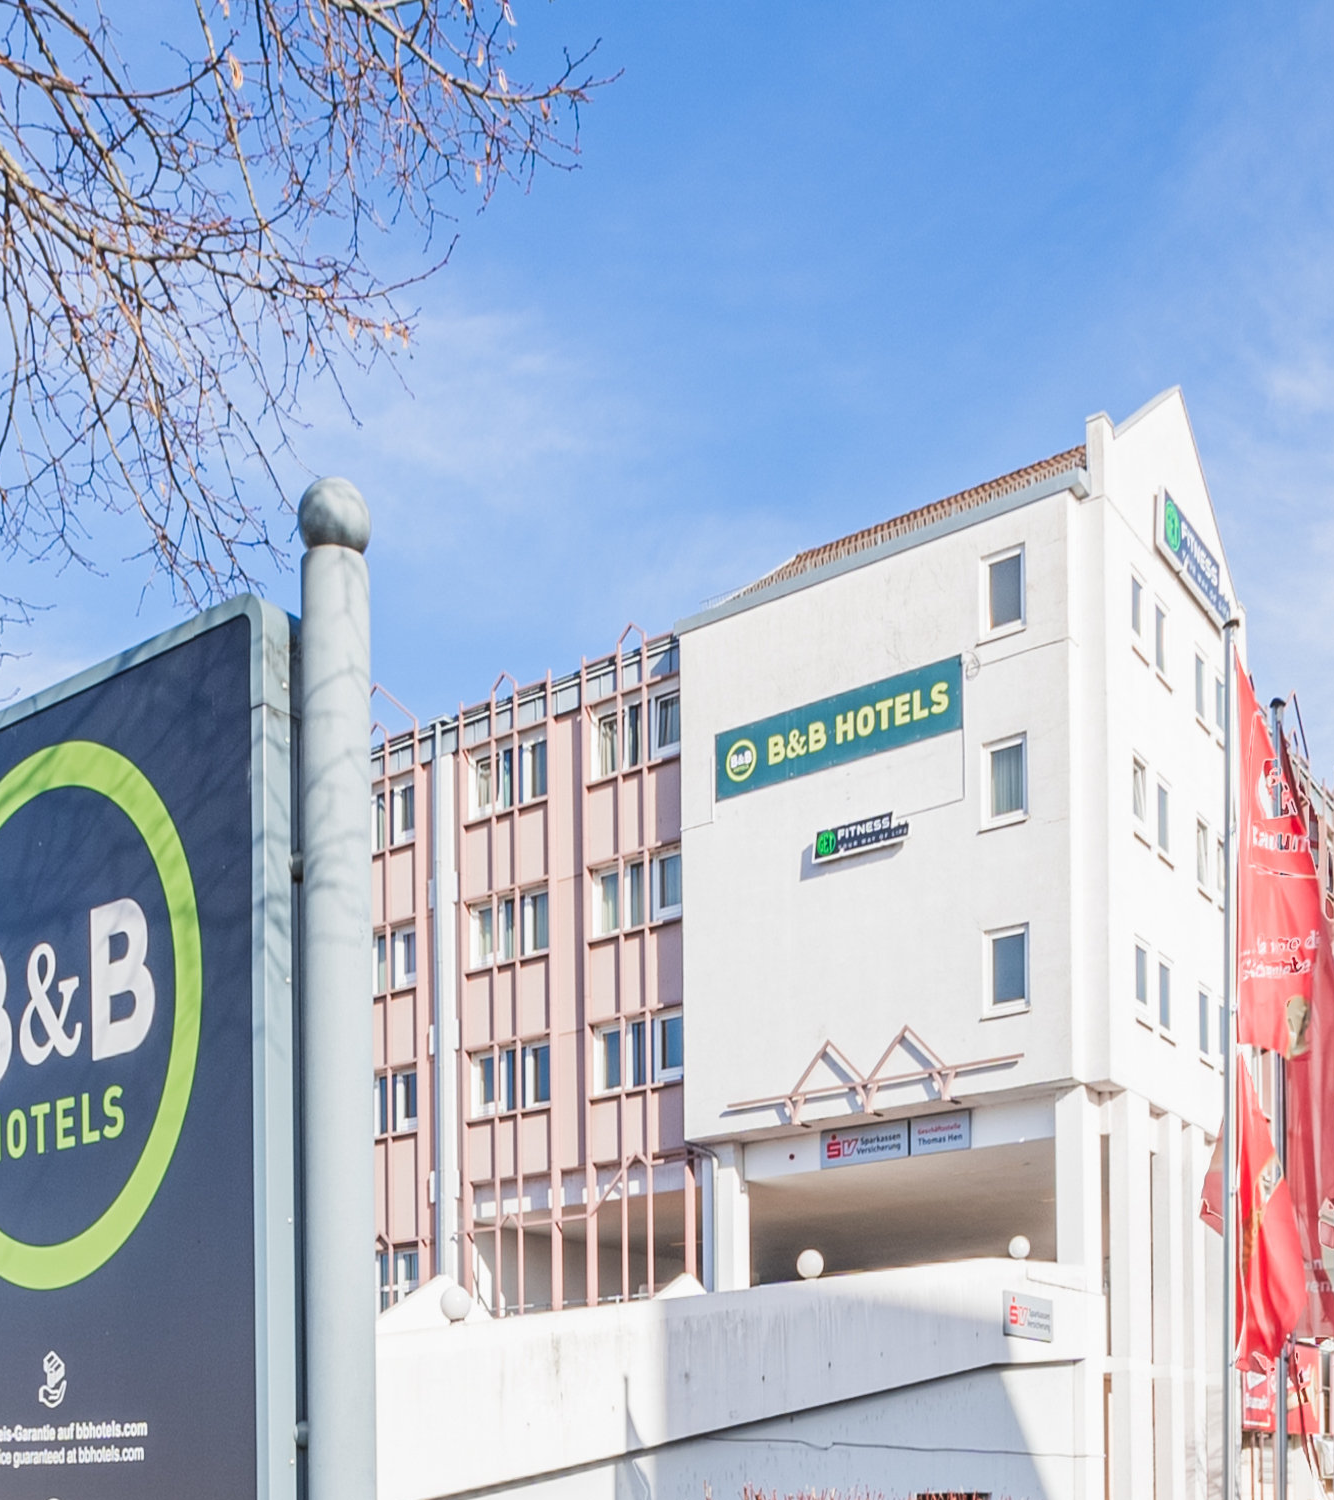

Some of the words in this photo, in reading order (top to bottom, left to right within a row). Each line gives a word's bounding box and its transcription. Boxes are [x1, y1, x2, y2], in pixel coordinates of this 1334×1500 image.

[768, 721, 827, 766] B&B
[835, 681, 949, 745] HOTELS
[837, 816, 890, 841] FITNESS
[857, 1143, 901, 1155] Versicherung
[860, 1133, 901, 1146] Sparkassen
[918, 1135, 946, 1147] Thomas
[57, 1422, 75, 1441] auf
[75, 1419, 148, 1440] bbhotels.com
[13, 1446, 65, 1469] guaranteed
[66, 1447, 77, 1464] at
[78, 1444, 145, 1464] bbhotels.com
